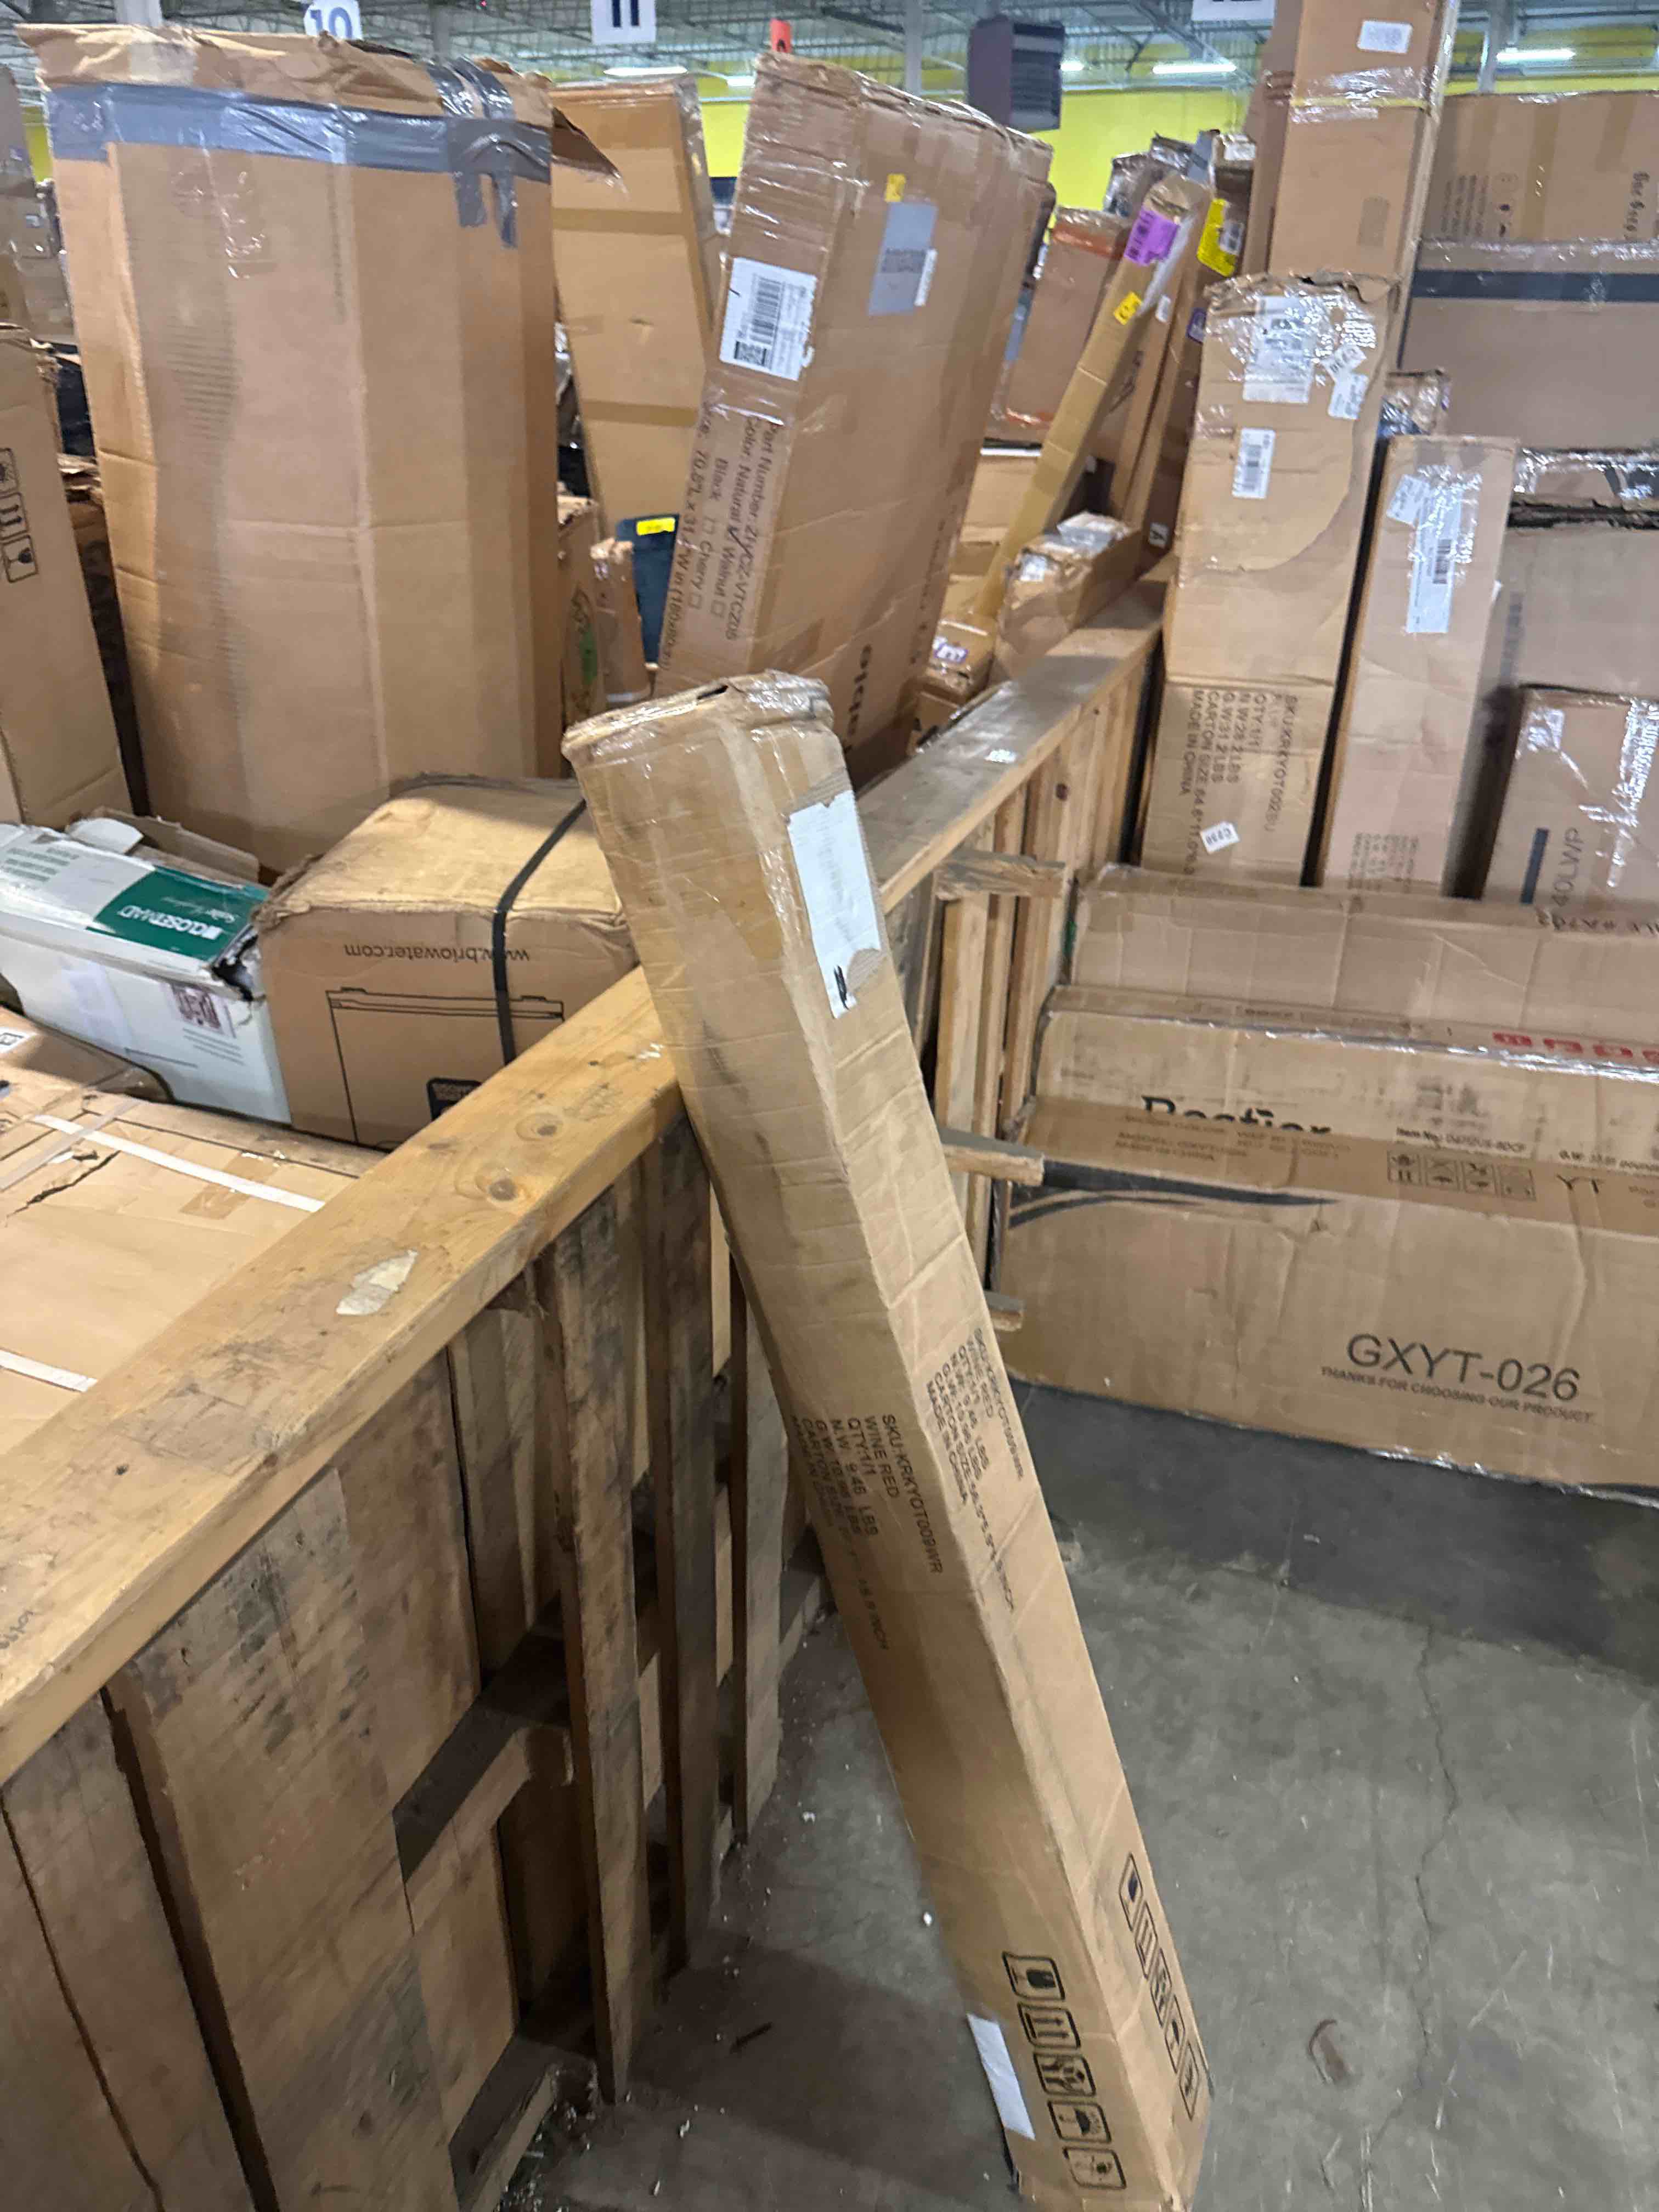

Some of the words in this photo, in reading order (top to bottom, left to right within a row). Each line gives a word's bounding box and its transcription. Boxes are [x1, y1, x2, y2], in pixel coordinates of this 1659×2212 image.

[310, 7, 352, 39] 10
[1346, 1333, 1581, 1401] GXYT-026
[1379, 1376, 1408, 1391] FOR
[865, 1415, 887, 1460] WINE
[878, 1463, 900, 1498] RED
